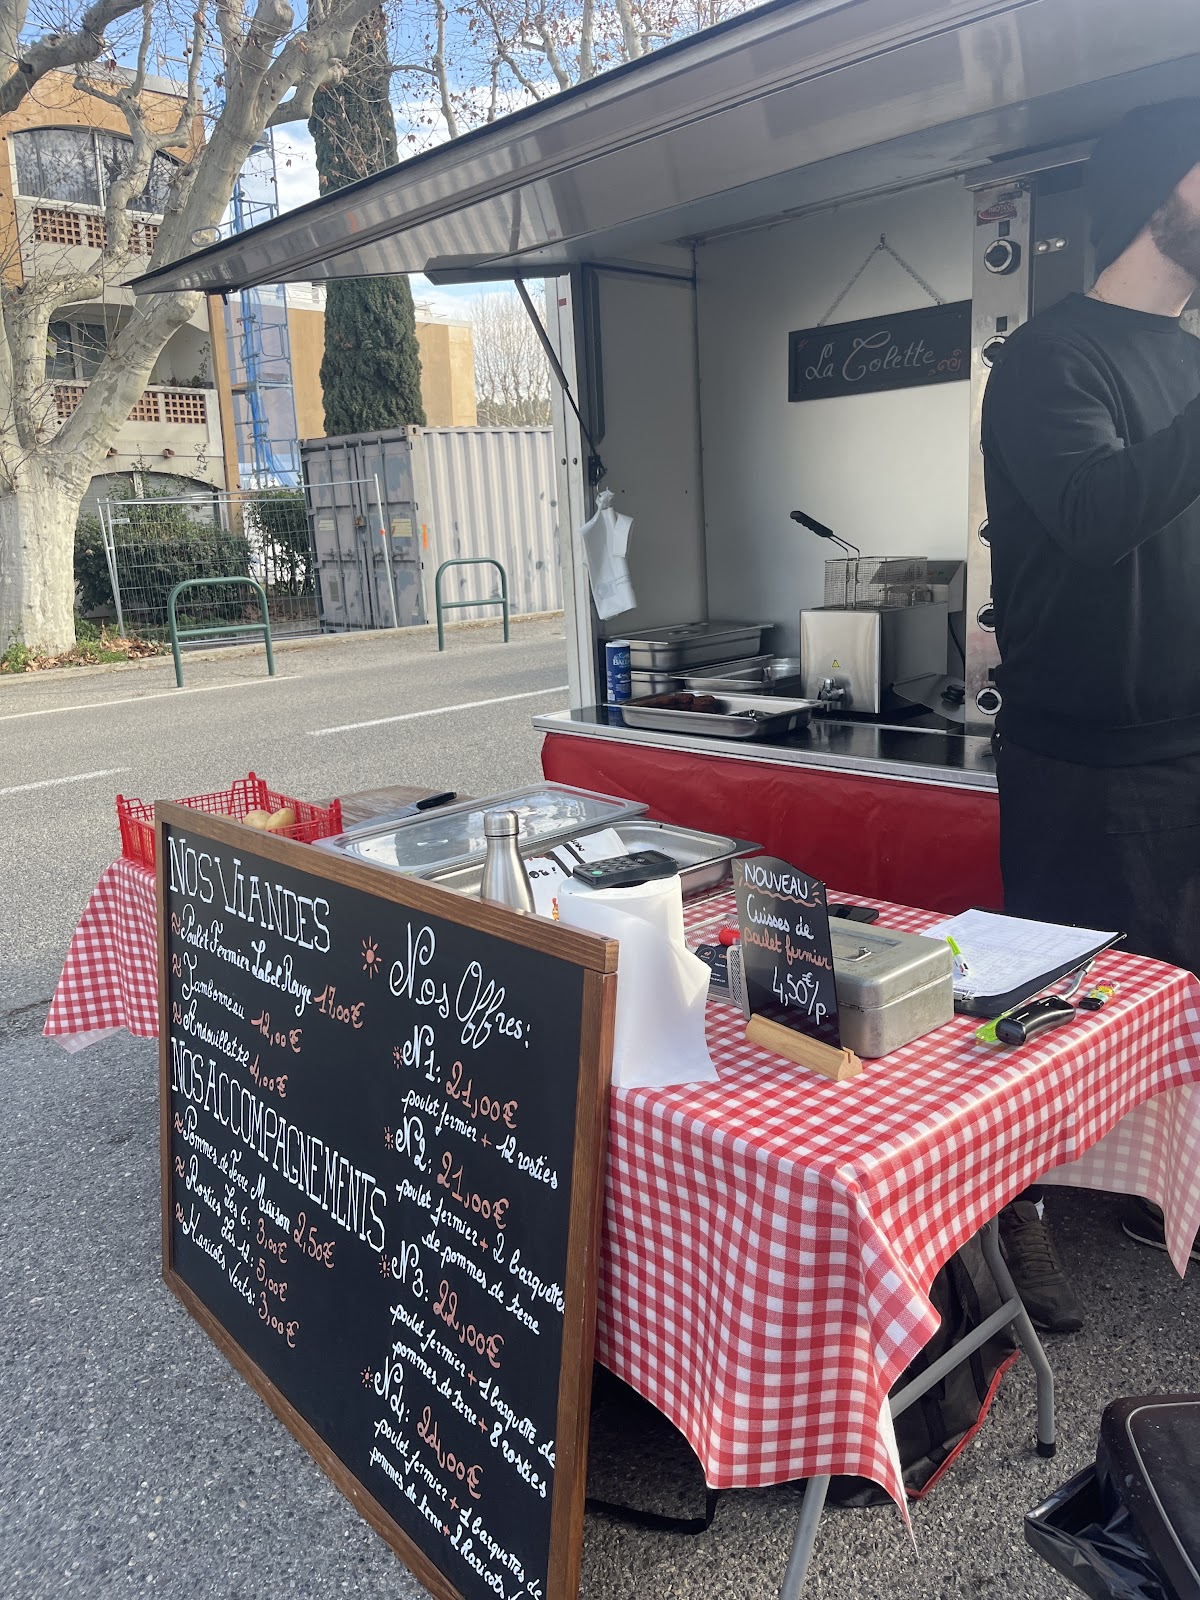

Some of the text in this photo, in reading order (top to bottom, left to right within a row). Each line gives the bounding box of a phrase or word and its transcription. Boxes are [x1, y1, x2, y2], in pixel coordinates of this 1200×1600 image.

[805, 331, 936, 382] La Colette
[168, 836, 331, 953] NOS VIANDES
[744, 862, 809, 900] NOUVEAU
[746, 893, 814, 940] Cuisses de
[181, 904, 209, 950] Poulet
[210, 920, 250, 972] Fermier
[251, 940, 283, 988] Label
[282, 955, 312, 1017] Rouge
[181, 952, 245, 1020] Jambonneau
[389, 922, 450, 1019] Nos
[743, 926, 833, 970] poulet fermier
[182, 999, 250, 1067] Andouillette
[445, 1060, 518, 1129] 21,00€
[171, 1036, 387, 1253] NOS ACCOMPAGNEMENTS
[401, 1089, 558, 1190] poulet fermier + 12 rosties
[183, 1105, 336, 1268] Pommes de Terre Maison 2,50€
[186, 1154, 221, 1217] Rosties
[396, 1178, 432, 1210] poulet
[431, 1197, 478, 1247] fermier
[493, 1232, 505, 1264] 2
[436, 1151, 510, 1230] 21,00€
[182, 1203, 226, 1271] Haricots
[422, 1230, 540, 1336] de pommes de terre
[432, 1279, 505, 1369] 22,00€
[390, 1303, 425, 1338] poulet
[421, 1328, 466, 1378] fermier
[478, 1377, 493, 1401] 1
[490, 1385, 536, 1445] barquette
[538, 1440, 556, 1470] de
[392, 1340, 437, 1386] pommes
[436, 1377, 453, 1400] de
[452, 1390, 477, 1426] terre
[490, 1421, 503, 1449] 8
[501, 1438, 547, 1499] rosties
[369, 1446, 404, 1491] pommes
[403, 1483, 417, 1505] de
[417, 1495, 443, 1533] terre
[417, 1405, 483, 1500] 24,00€
[374, 1418, 409, 1458] poulet
[405, 1450, 449, 1502] fermier
[472, 1516, 525, 1583] barquettes
[526, 1578, 543, 1600] de
